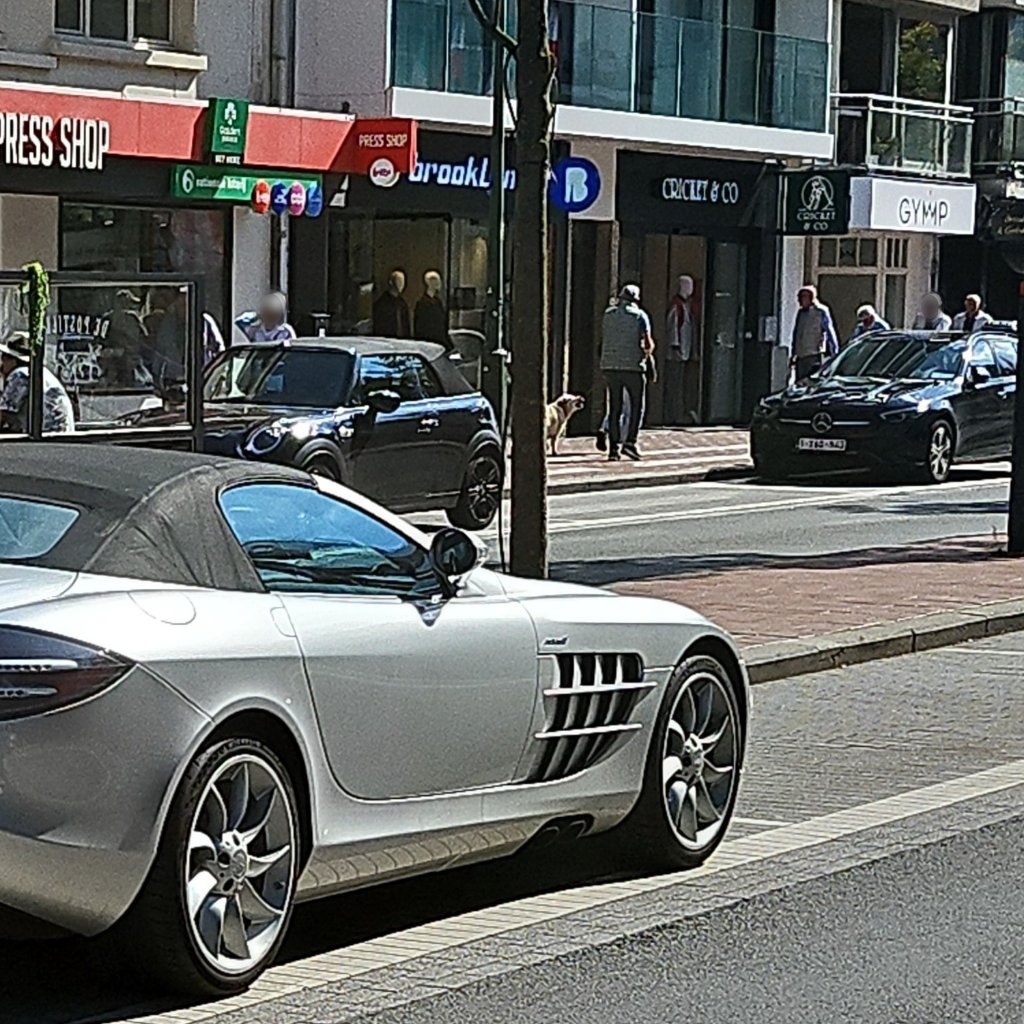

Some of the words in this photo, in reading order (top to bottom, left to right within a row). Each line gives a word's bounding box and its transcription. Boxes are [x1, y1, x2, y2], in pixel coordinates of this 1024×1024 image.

[59, 117, 110, 170] SHOP
[359, 133, 384, 148] PRESS
[386, 133, 408, 148] SHOP
[408, 154, 516, 195] brookln
[662, 177, 708, 201] CRICKET
[710, 181, 719, 202] &
[721, 182, 739, 203] CO
[813, 221, 828, 231] CO
